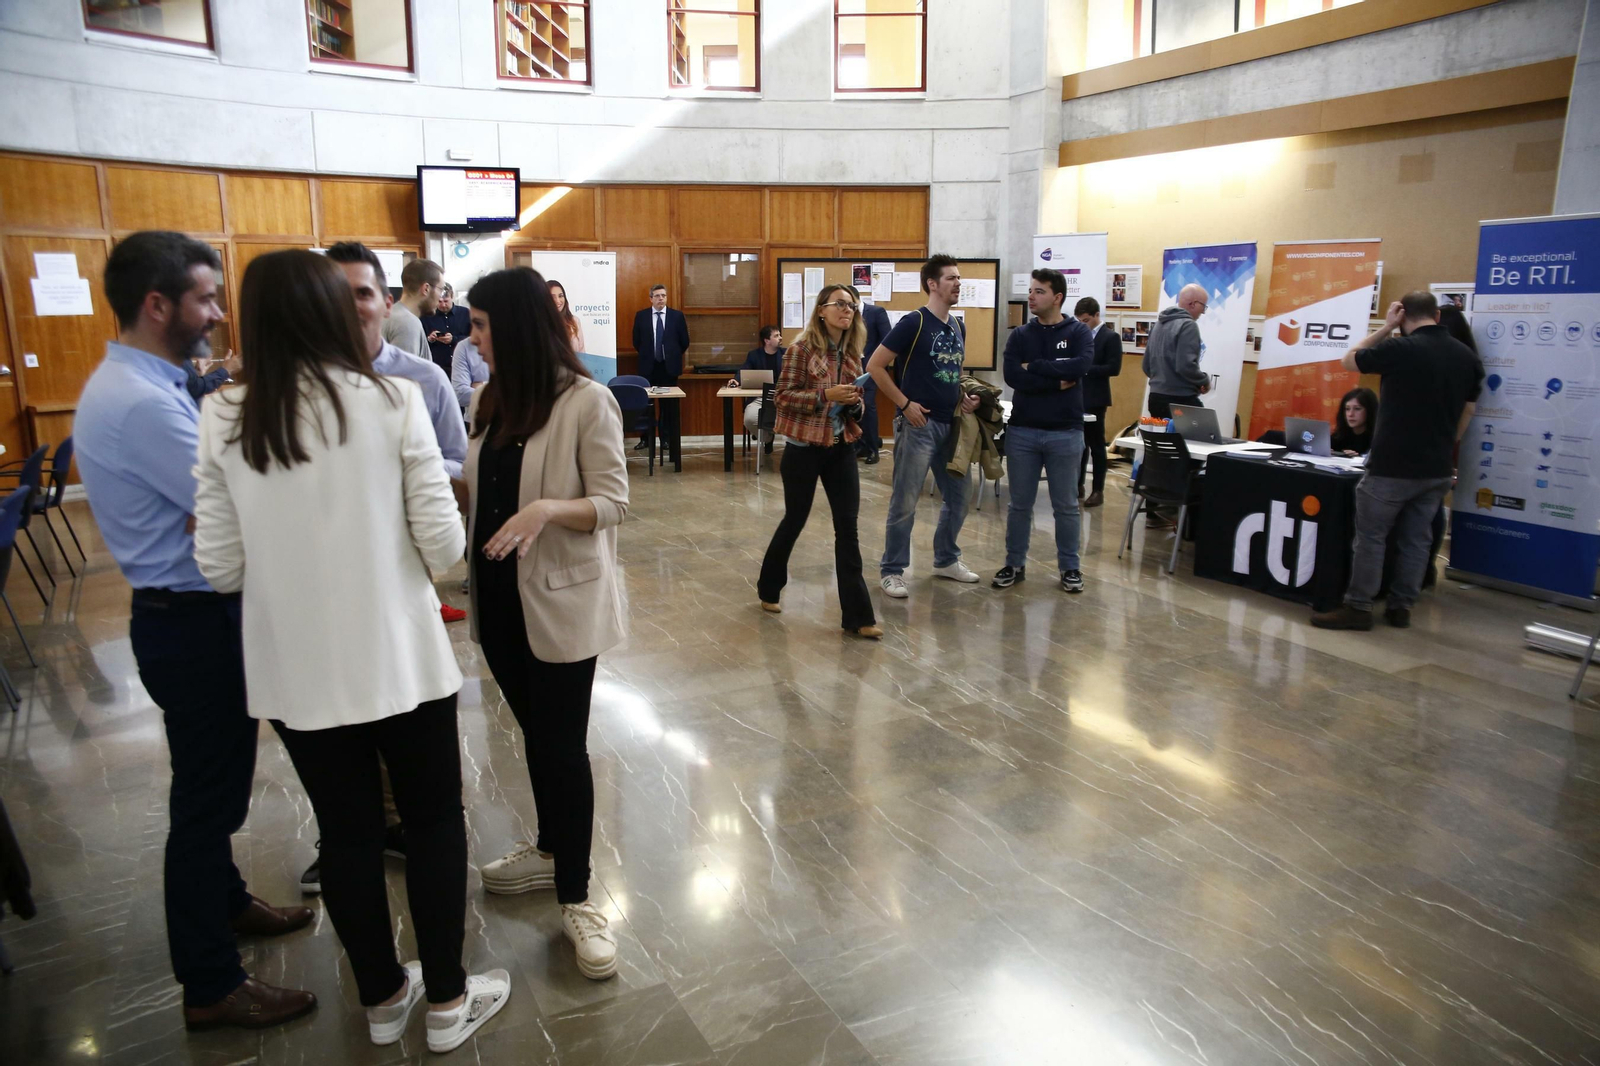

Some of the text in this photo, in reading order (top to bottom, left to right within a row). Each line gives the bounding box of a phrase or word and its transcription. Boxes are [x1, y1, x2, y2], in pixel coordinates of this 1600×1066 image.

[1491, 251, 1577, 264] Be exceptional.
[1489, 265, 1576, 286] Be RTI.
[575, 304, 610, 312] proyecto
[1488, 303, 1519, 311] Leader
[1305, 323, 1351, 340] PC
[1056, 339, 1067, 349] rti
[1304, 340, 1349, 348] COMPONENTES
[1483, 356, 1516, 365] Culture
[1477, 405, 1514, 415] Benefits
[1233, 495, 1321, 588] rti
